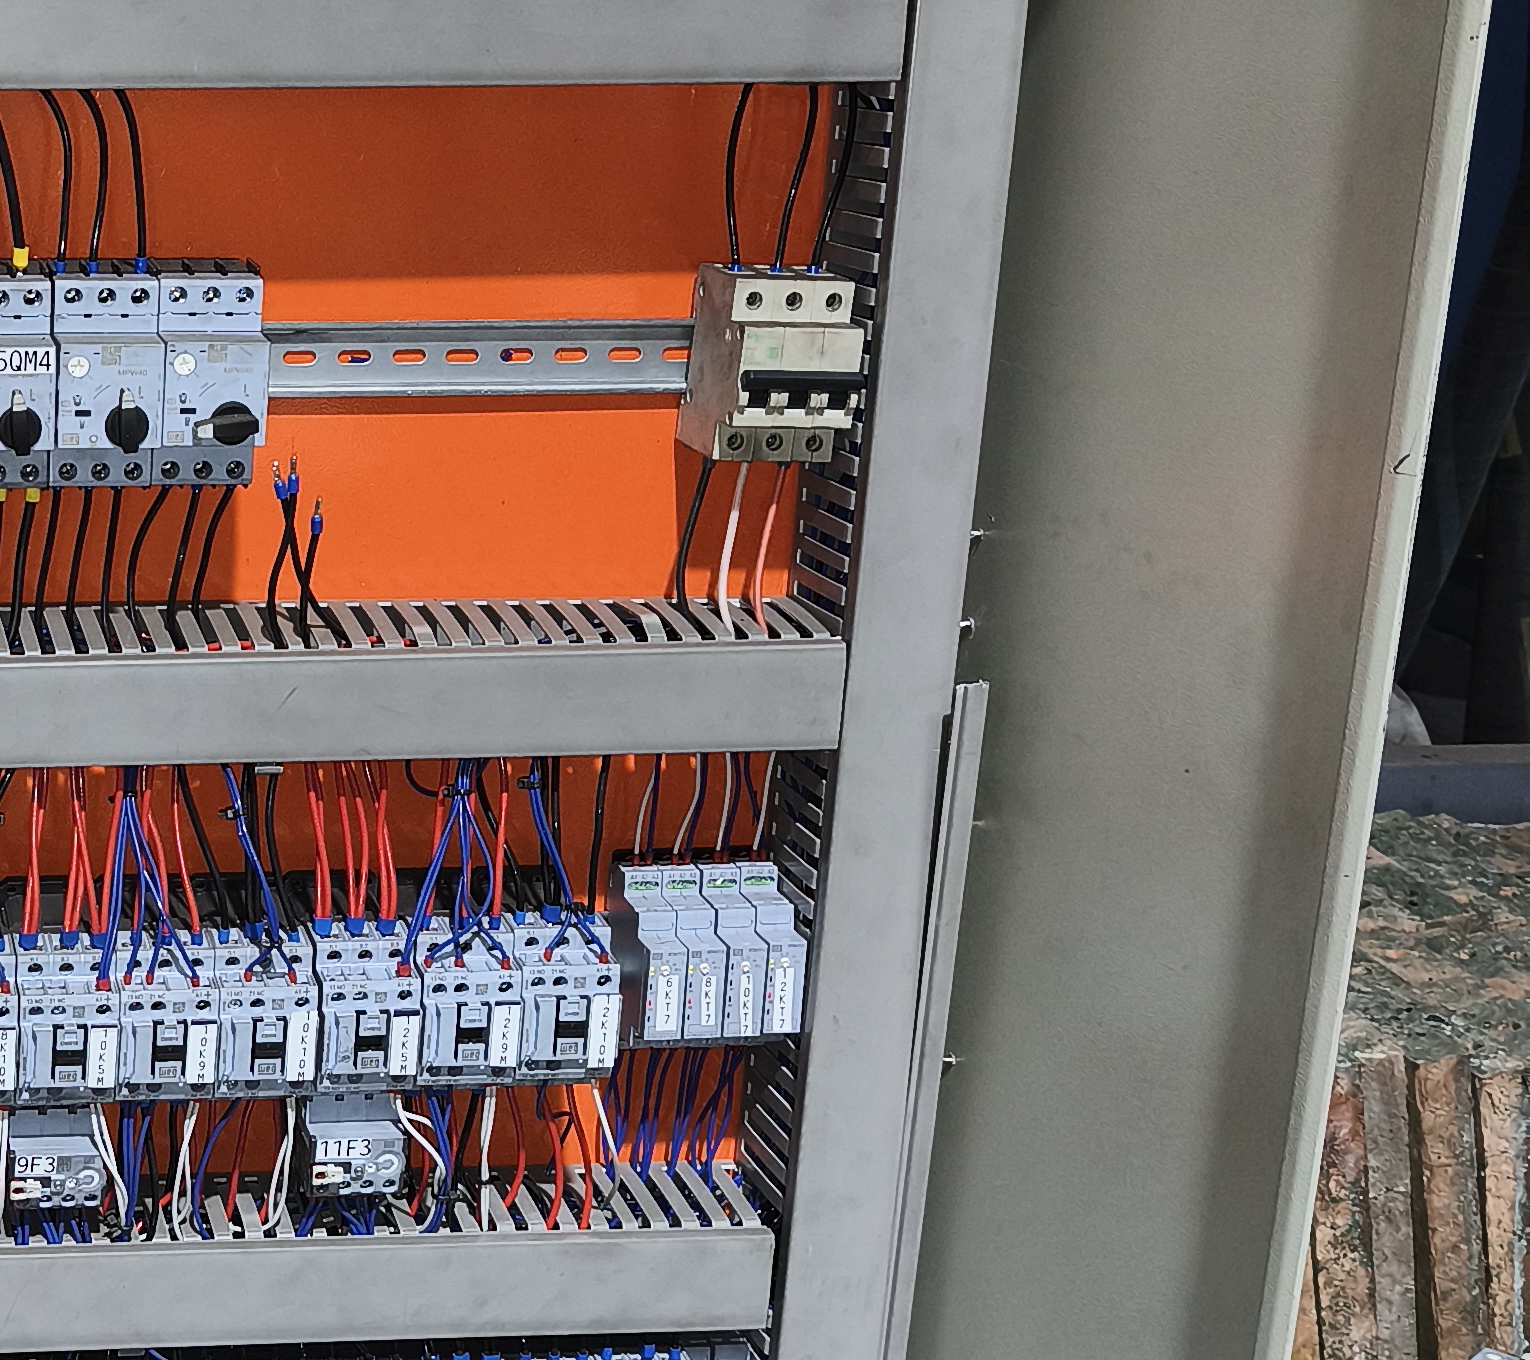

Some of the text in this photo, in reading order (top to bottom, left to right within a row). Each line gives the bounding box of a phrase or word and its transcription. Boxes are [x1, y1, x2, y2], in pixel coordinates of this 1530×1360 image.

[117, 369, 148, 377] MPW40
[223, 367, 254, 375] MPW40
[664, 978, 673, 1024] 6KT7
[704, 978, 712, 1024] 8KT7
[742, 975, 751, 1035] 10KT7
[779, 968, 787, 1028] 12KT7
[96, 1029, 107, 1086] 10K5M
[197, 1026, 208, 1082] 10K9M
[297, 1011, 312, 1082] 10K10M
[400, 1016, 411, 1074] 12K5M
[500, 1006, 511, 1064] 12K9M
[598, 995, 611, 1067] 12K10M
[17, 1156, 56, 1174] 9F3
[320, 1139, 372, 1158] 11F3
